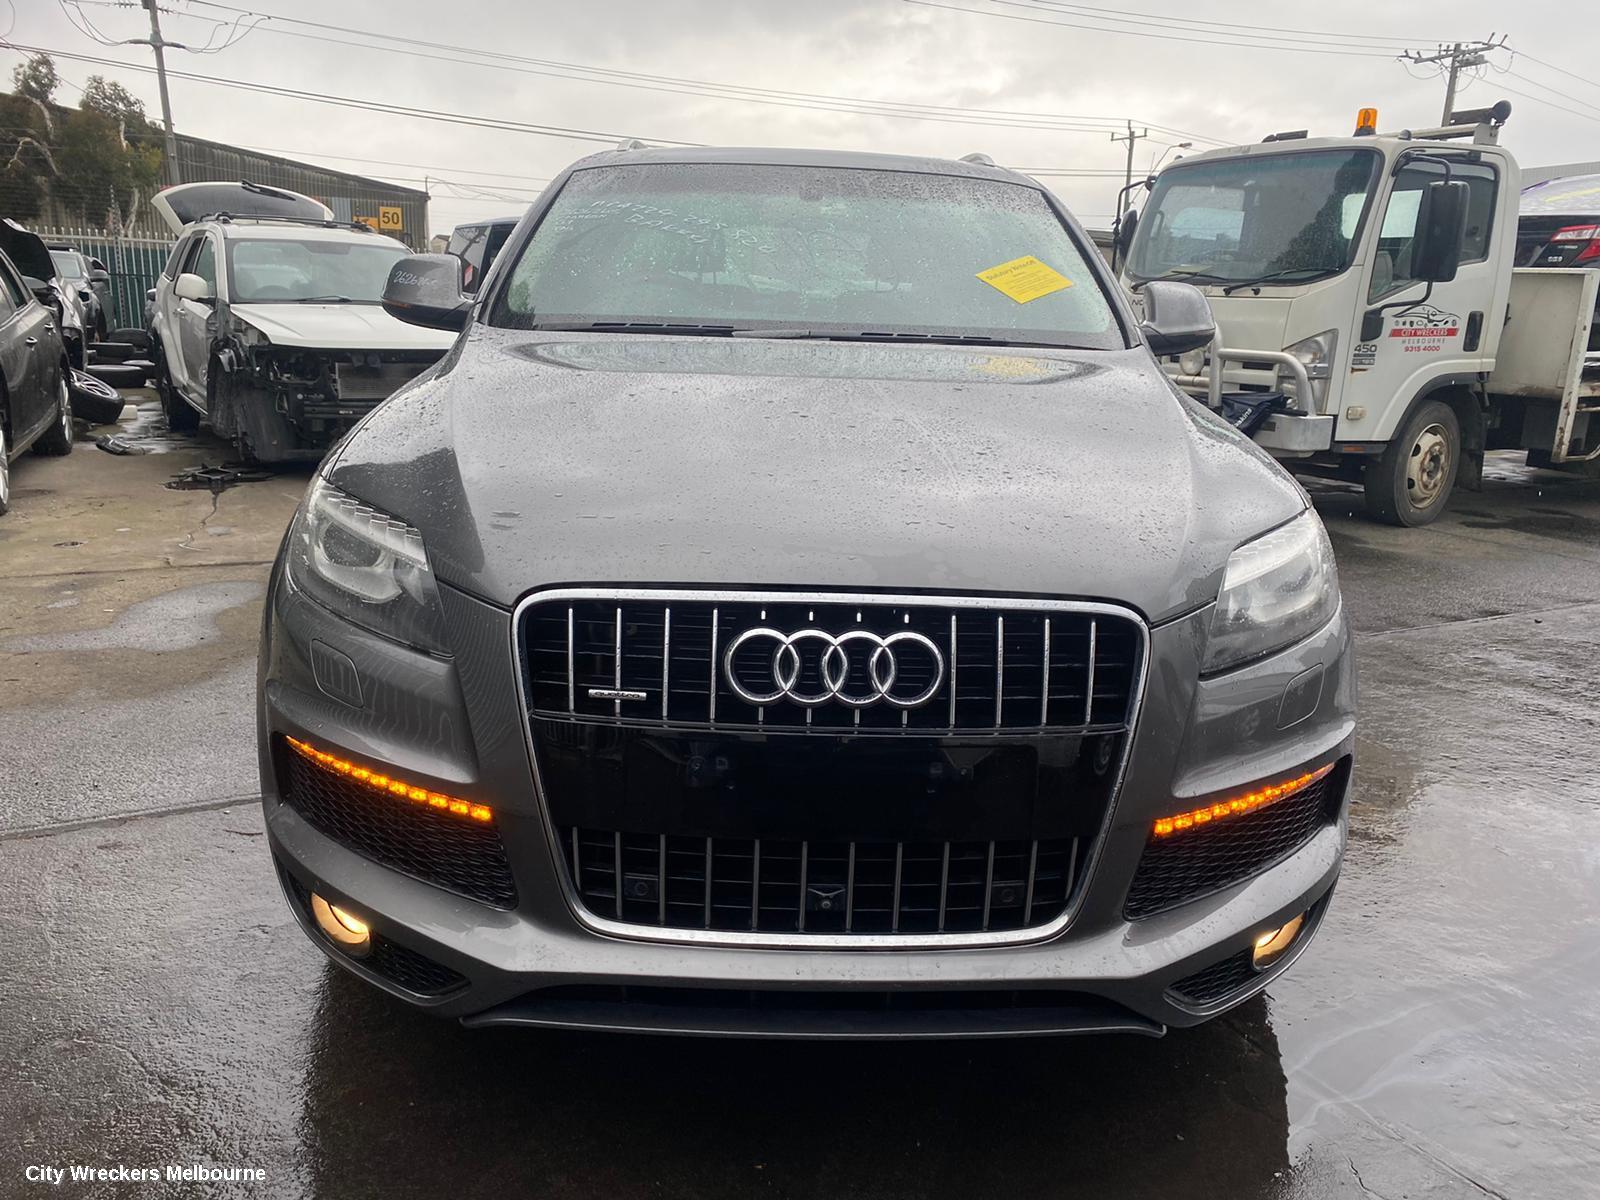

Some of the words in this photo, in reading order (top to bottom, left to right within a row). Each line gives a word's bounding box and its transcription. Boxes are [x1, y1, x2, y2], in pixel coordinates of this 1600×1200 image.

[382, 211, 400, 225] 50
[1401, 328, 1415, 336] CITY
[1416, 328, 1448, 336] WRECKERS
[1354, 344, 1377, 352] 450
